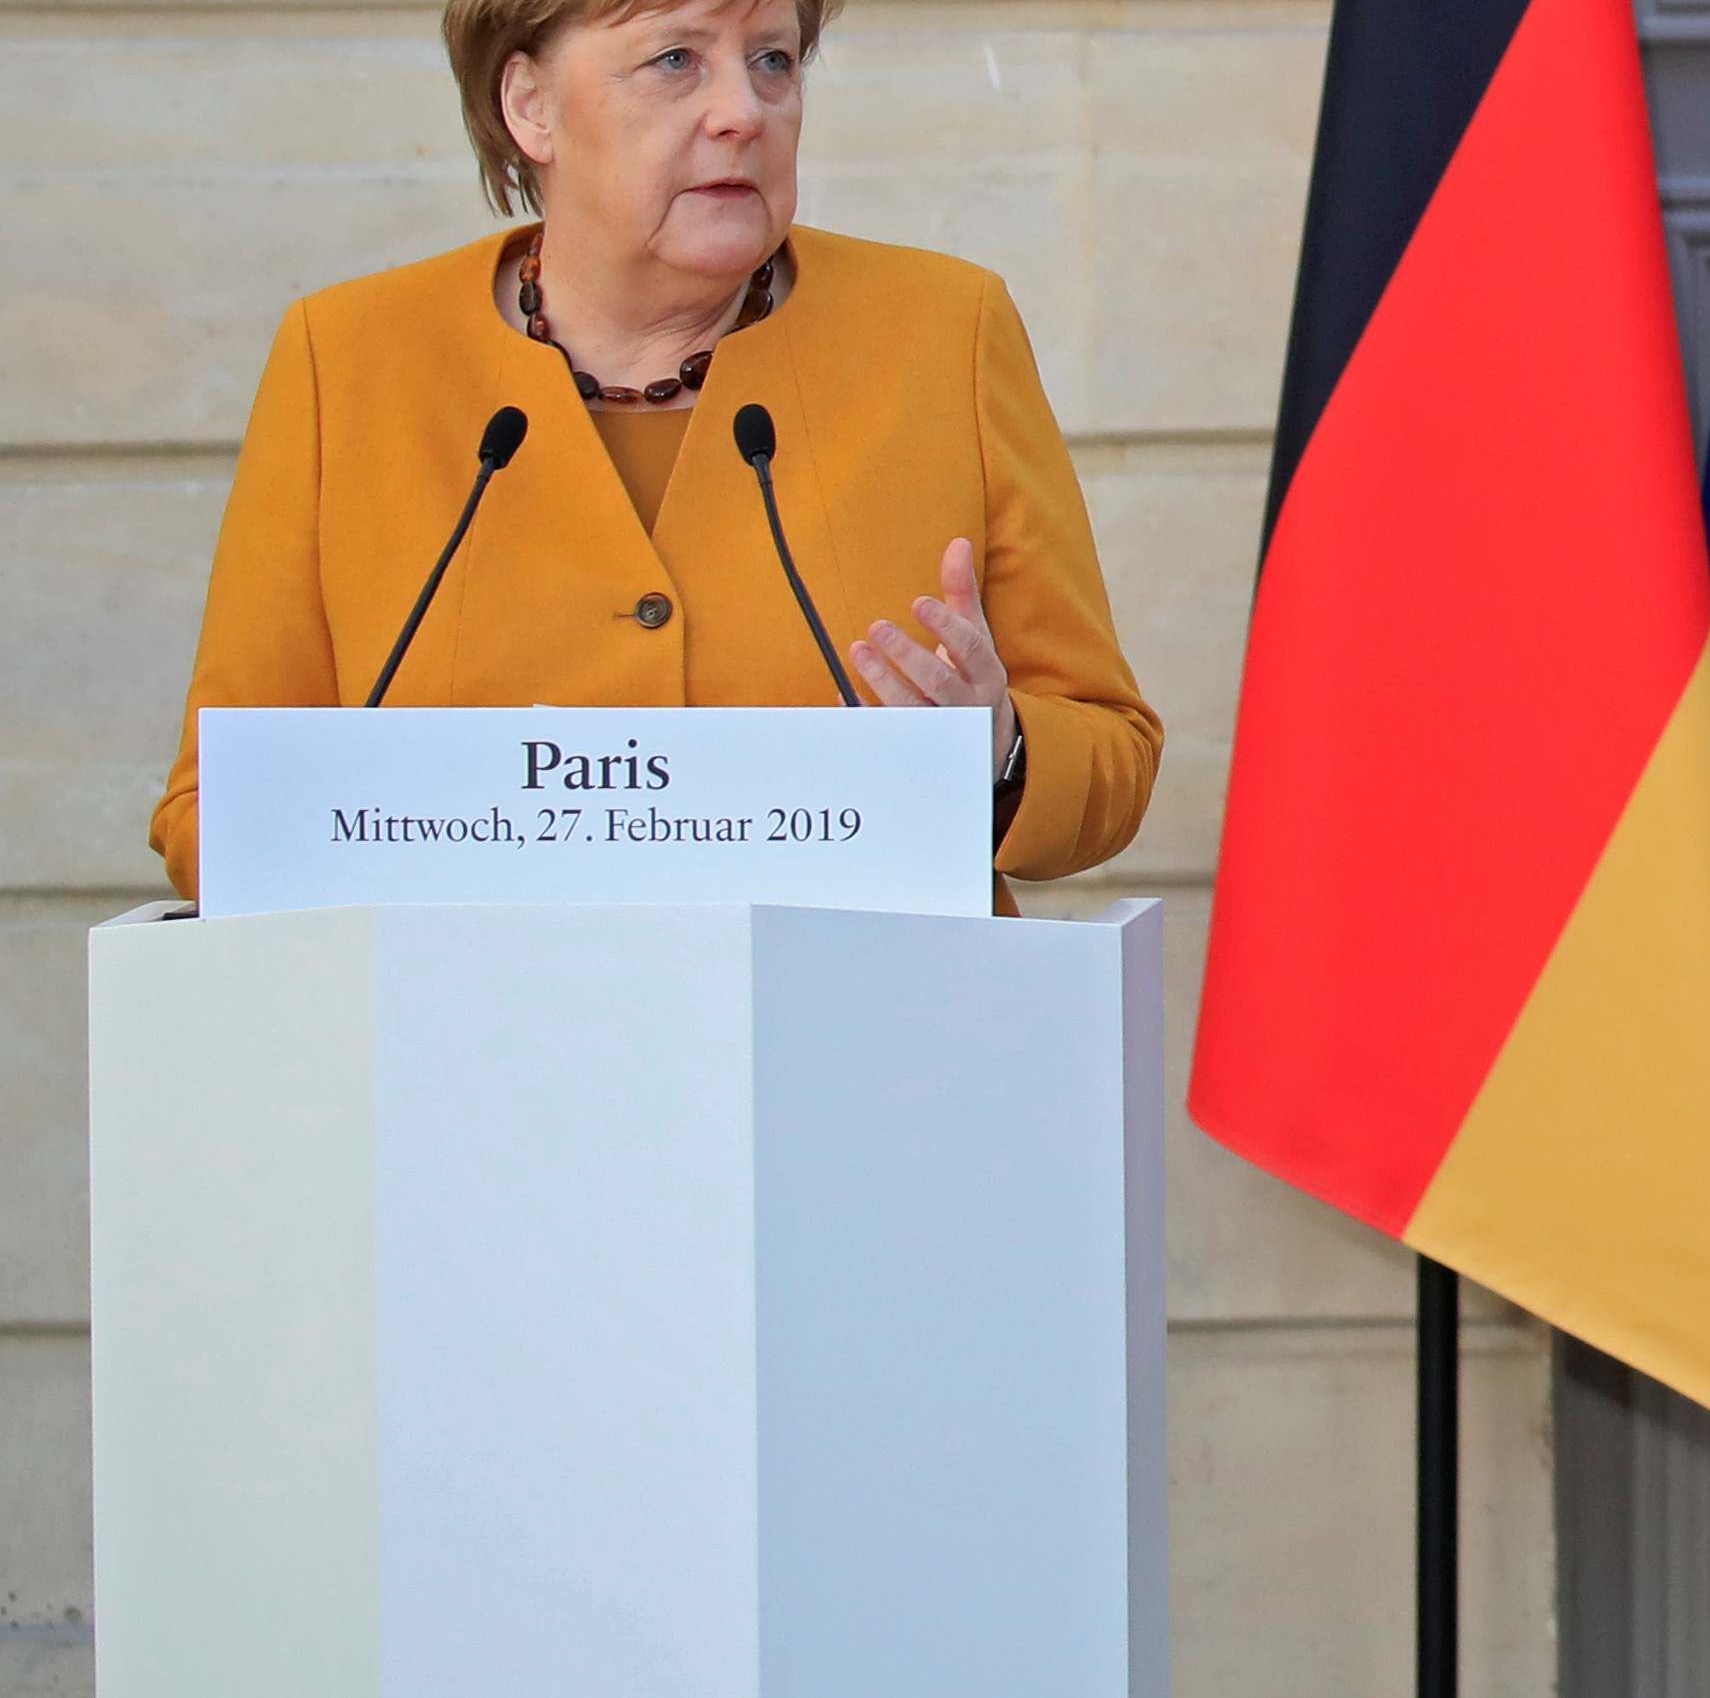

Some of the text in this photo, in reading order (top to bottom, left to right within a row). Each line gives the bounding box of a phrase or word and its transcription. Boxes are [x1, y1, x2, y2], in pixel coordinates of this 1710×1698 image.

[520, 738, 669, 790] Paris
[330, 806, 861, 849] Mittwoch, 27. Februar 2019
